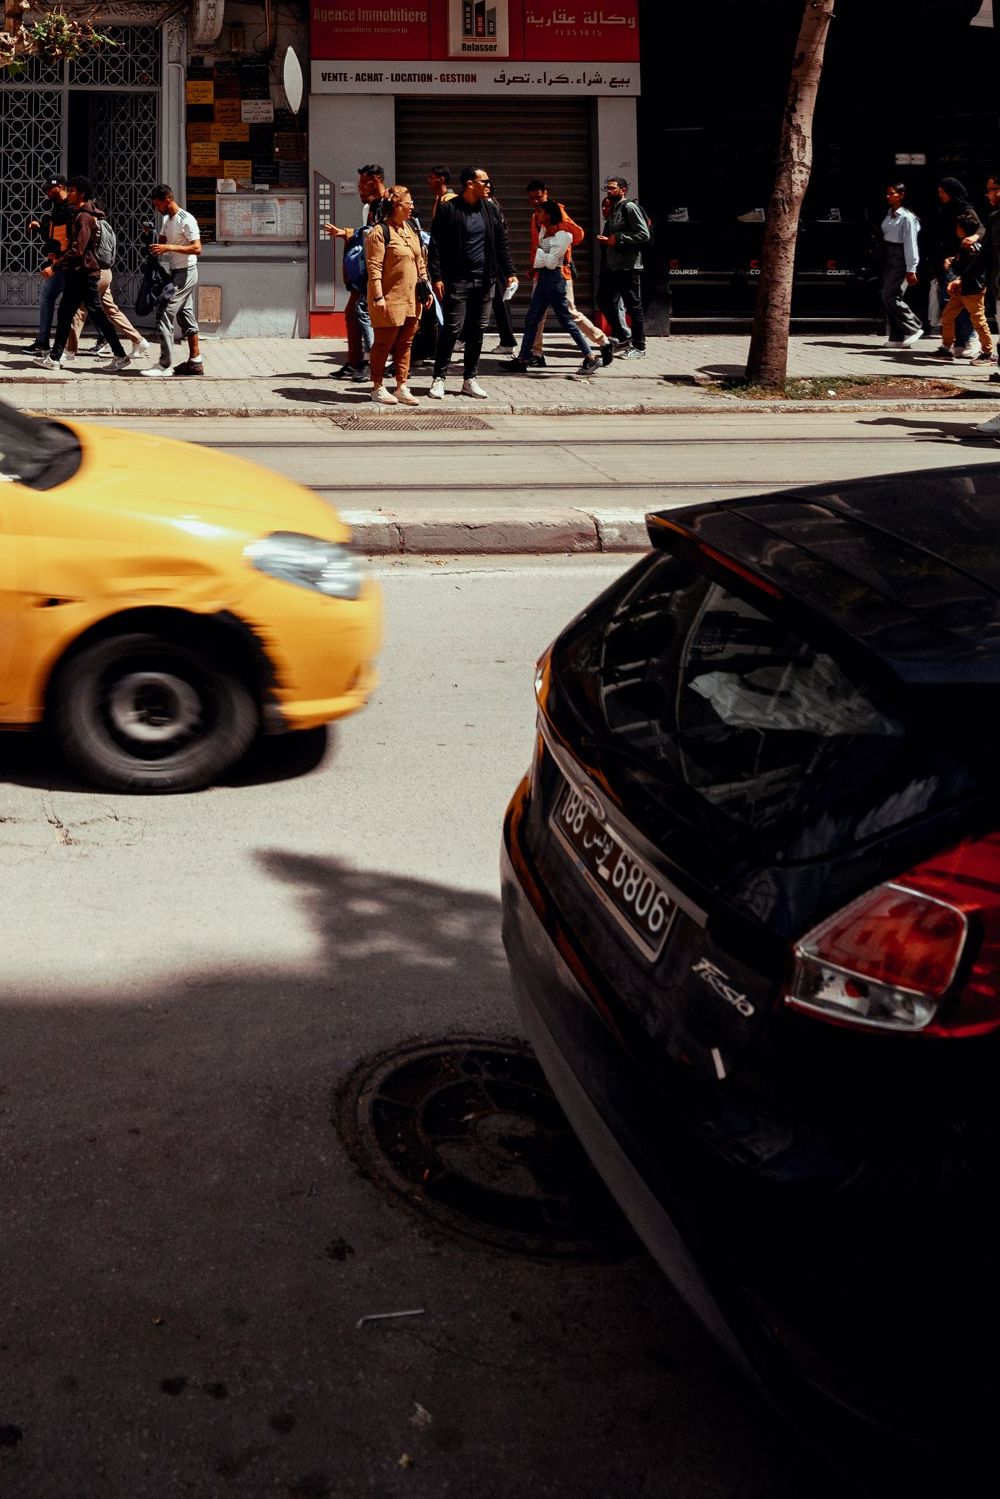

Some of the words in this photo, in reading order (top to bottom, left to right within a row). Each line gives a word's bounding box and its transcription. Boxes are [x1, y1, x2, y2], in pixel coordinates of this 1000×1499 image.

[313, 7, 356, 23] Agence
[358, 7, 427, 23] Immobilière
[526, 8, 576, 28] عقارية
[583, 9, 636, 29] وكالة
[461, 42, 498, 52] Relasser
[321, 72, 348, 82] VENTE
[354, 72, 383, 82] ACHAT
[390, 73, 433, 83] LOCATION
[439, 73, 477, 83] GESTION
[612, 851, 671, 932] 6806
